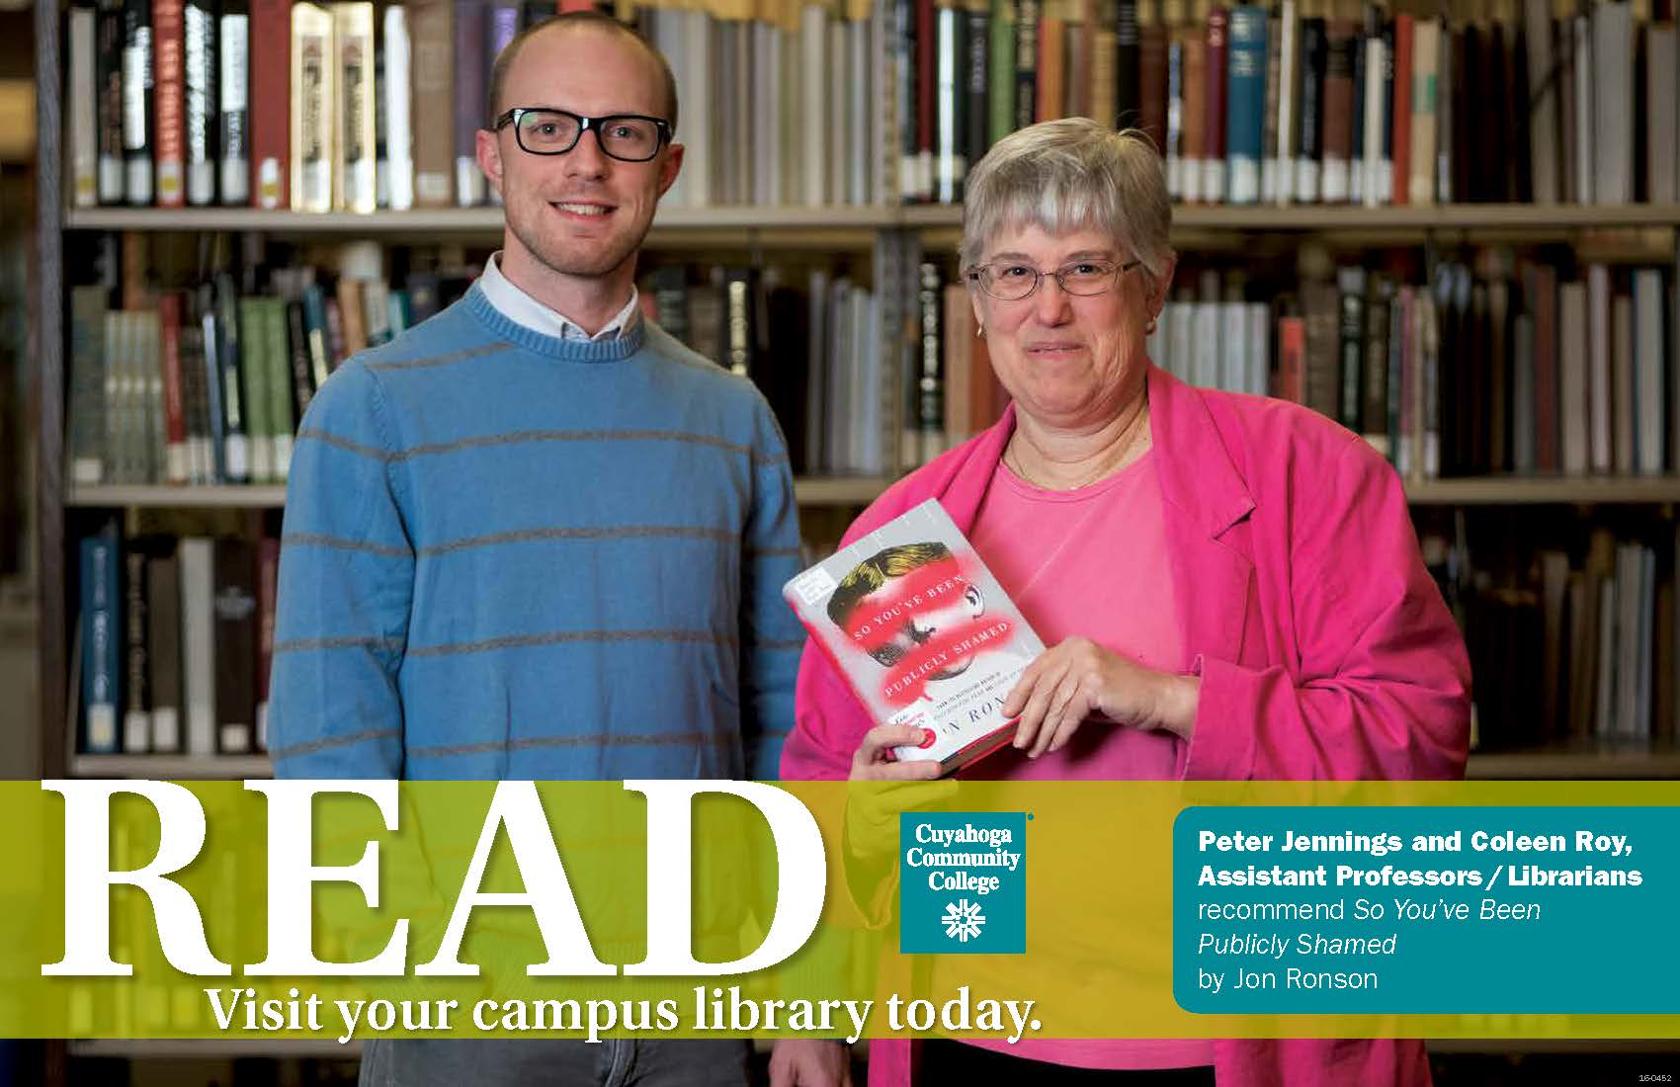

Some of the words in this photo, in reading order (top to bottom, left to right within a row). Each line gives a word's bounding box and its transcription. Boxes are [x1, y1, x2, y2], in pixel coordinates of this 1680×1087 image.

[853, 623, 872, 641] SO
[926, 575, 966, 599] BEEN
[884, 651, 950, 699] PUBLICLY
[953, 622, 1009, 656] SHAMED
